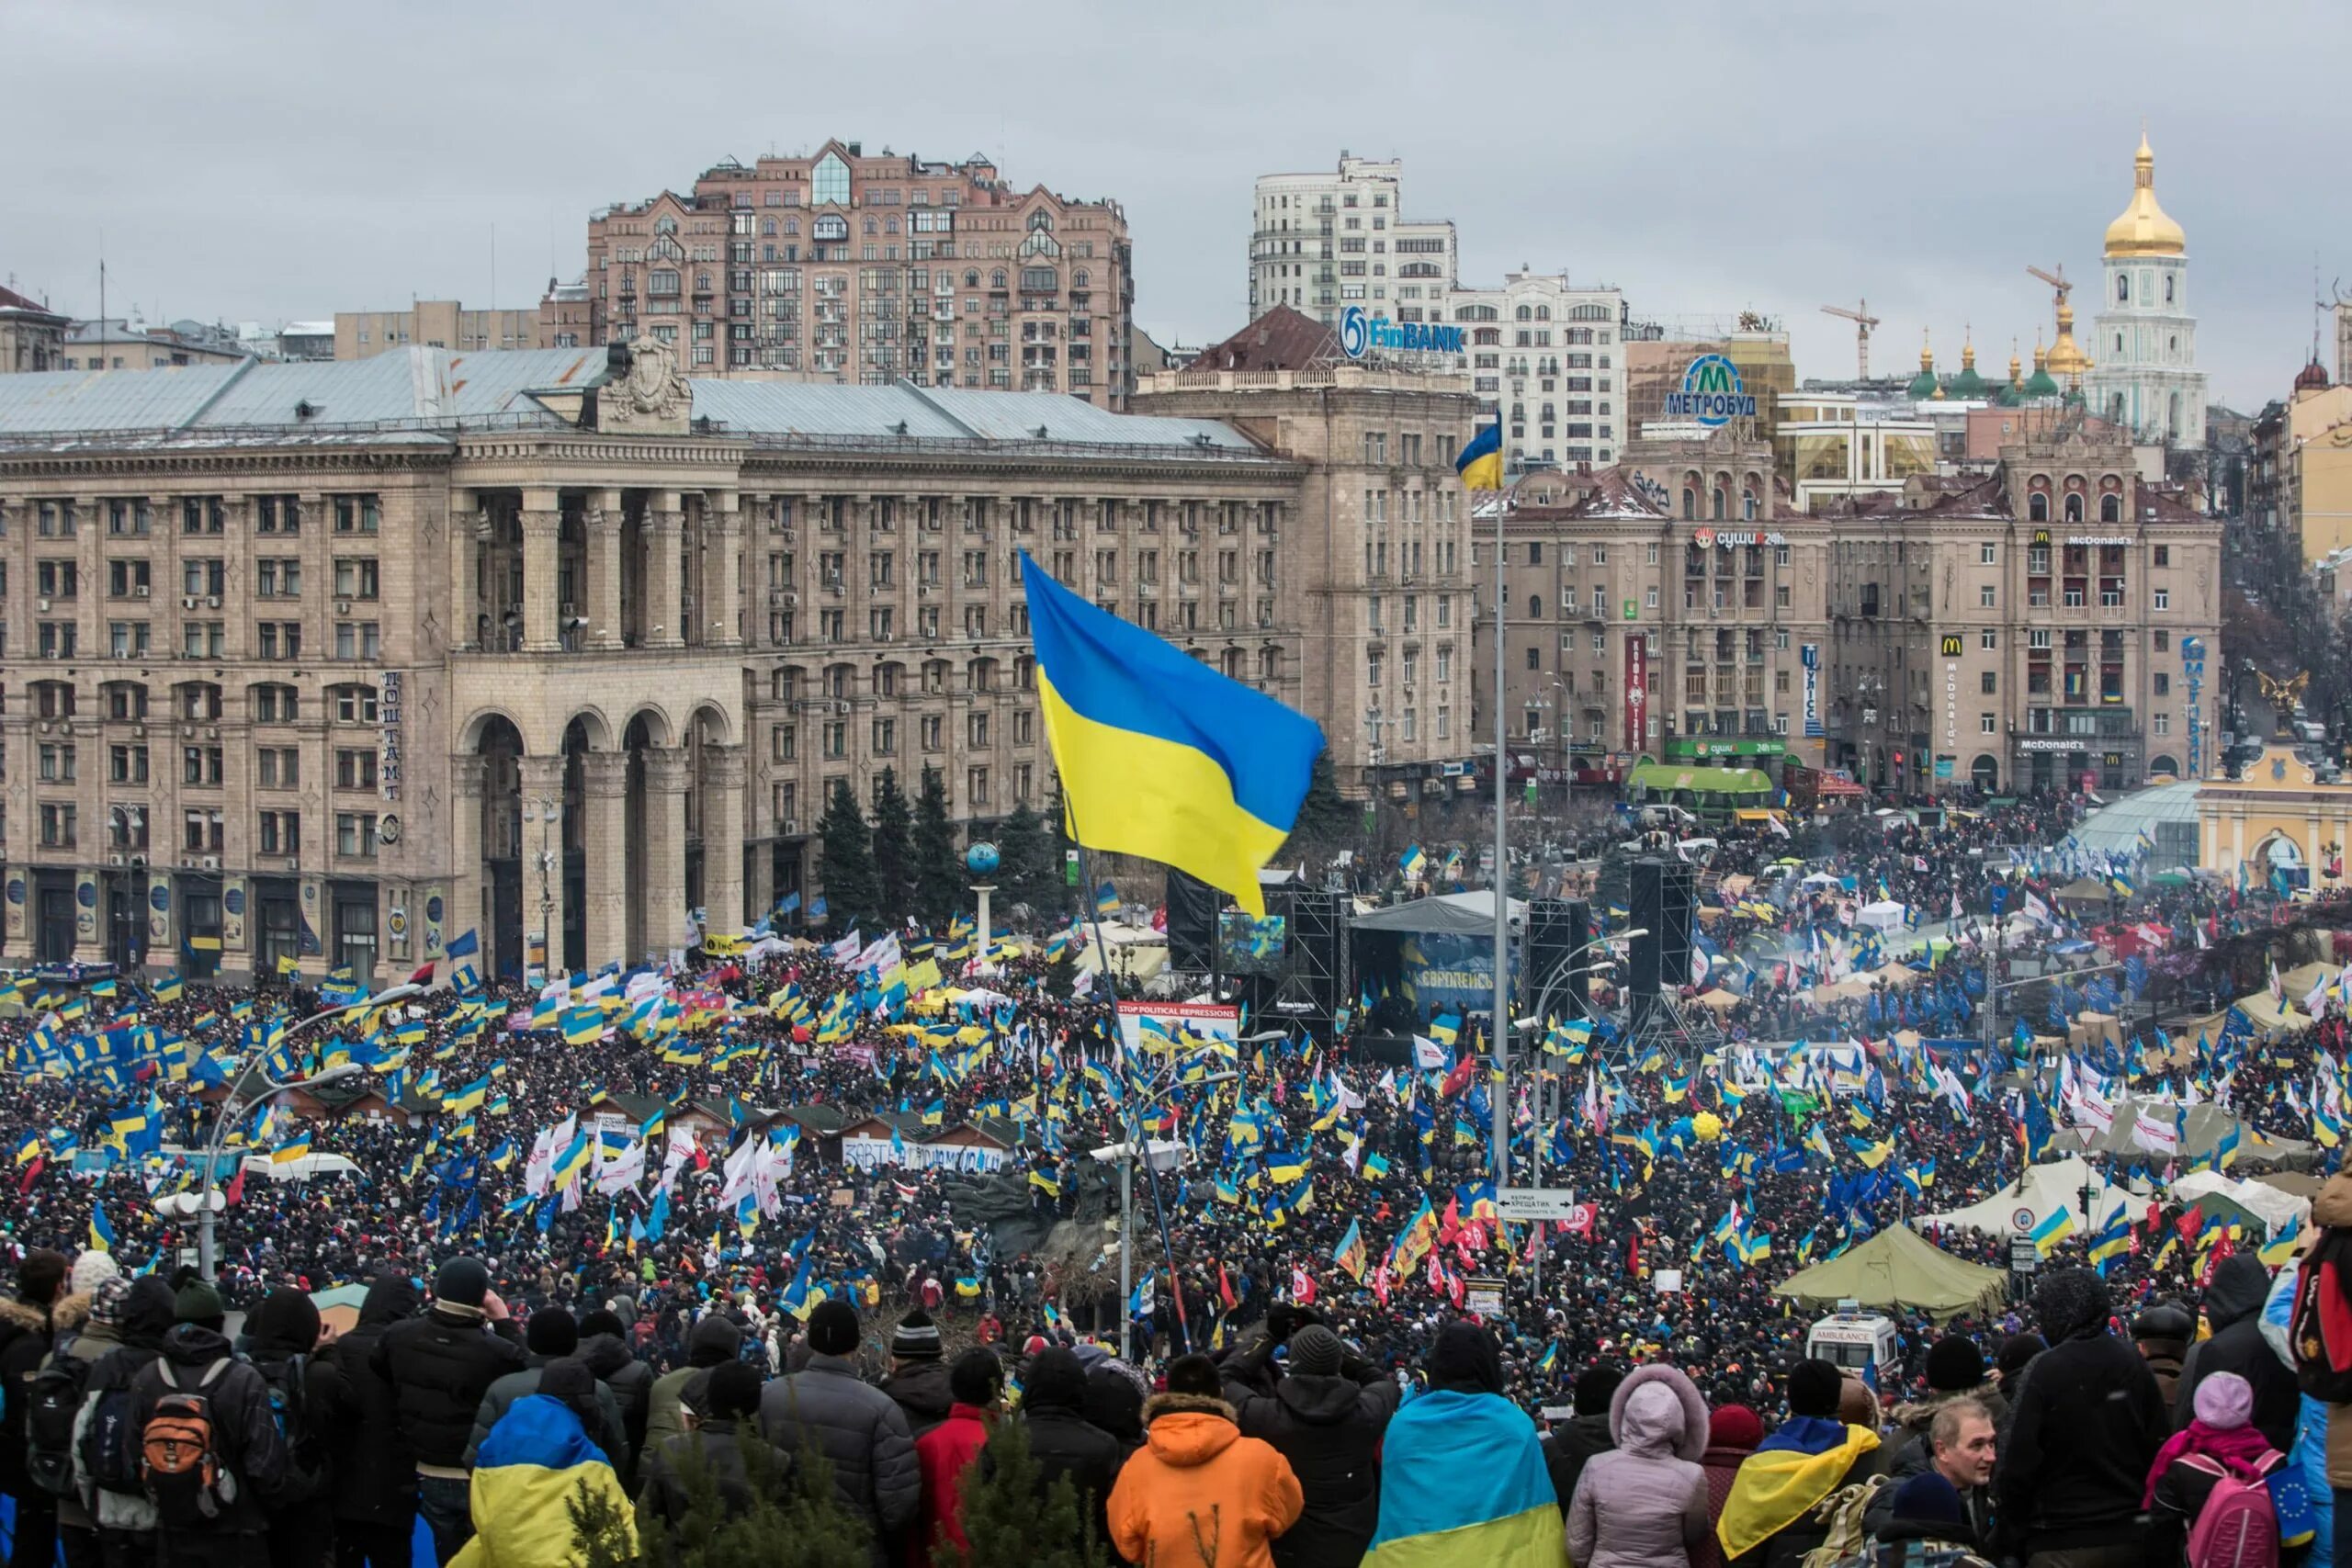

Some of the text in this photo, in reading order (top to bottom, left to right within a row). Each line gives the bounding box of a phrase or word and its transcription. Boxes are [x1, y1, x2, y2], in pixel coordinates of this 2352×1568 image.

[1370, 316, 1464, 354] FinBANK
[1668, 393, 1757, 416] МЕТРОБУД
[2068, 536, 2132, 545] McDonald's
[1947, 662, 1957, 747] McDonald's
[383, 671, 400, 800] ПОШТАМТ
[2021, 740, 2085, 750] McDonald's
[1118, 1005, 1236, 1019] STOP POLITICAL REPRESSIONS
[1816, 1331, 1870, 1341] AMBULANCE
